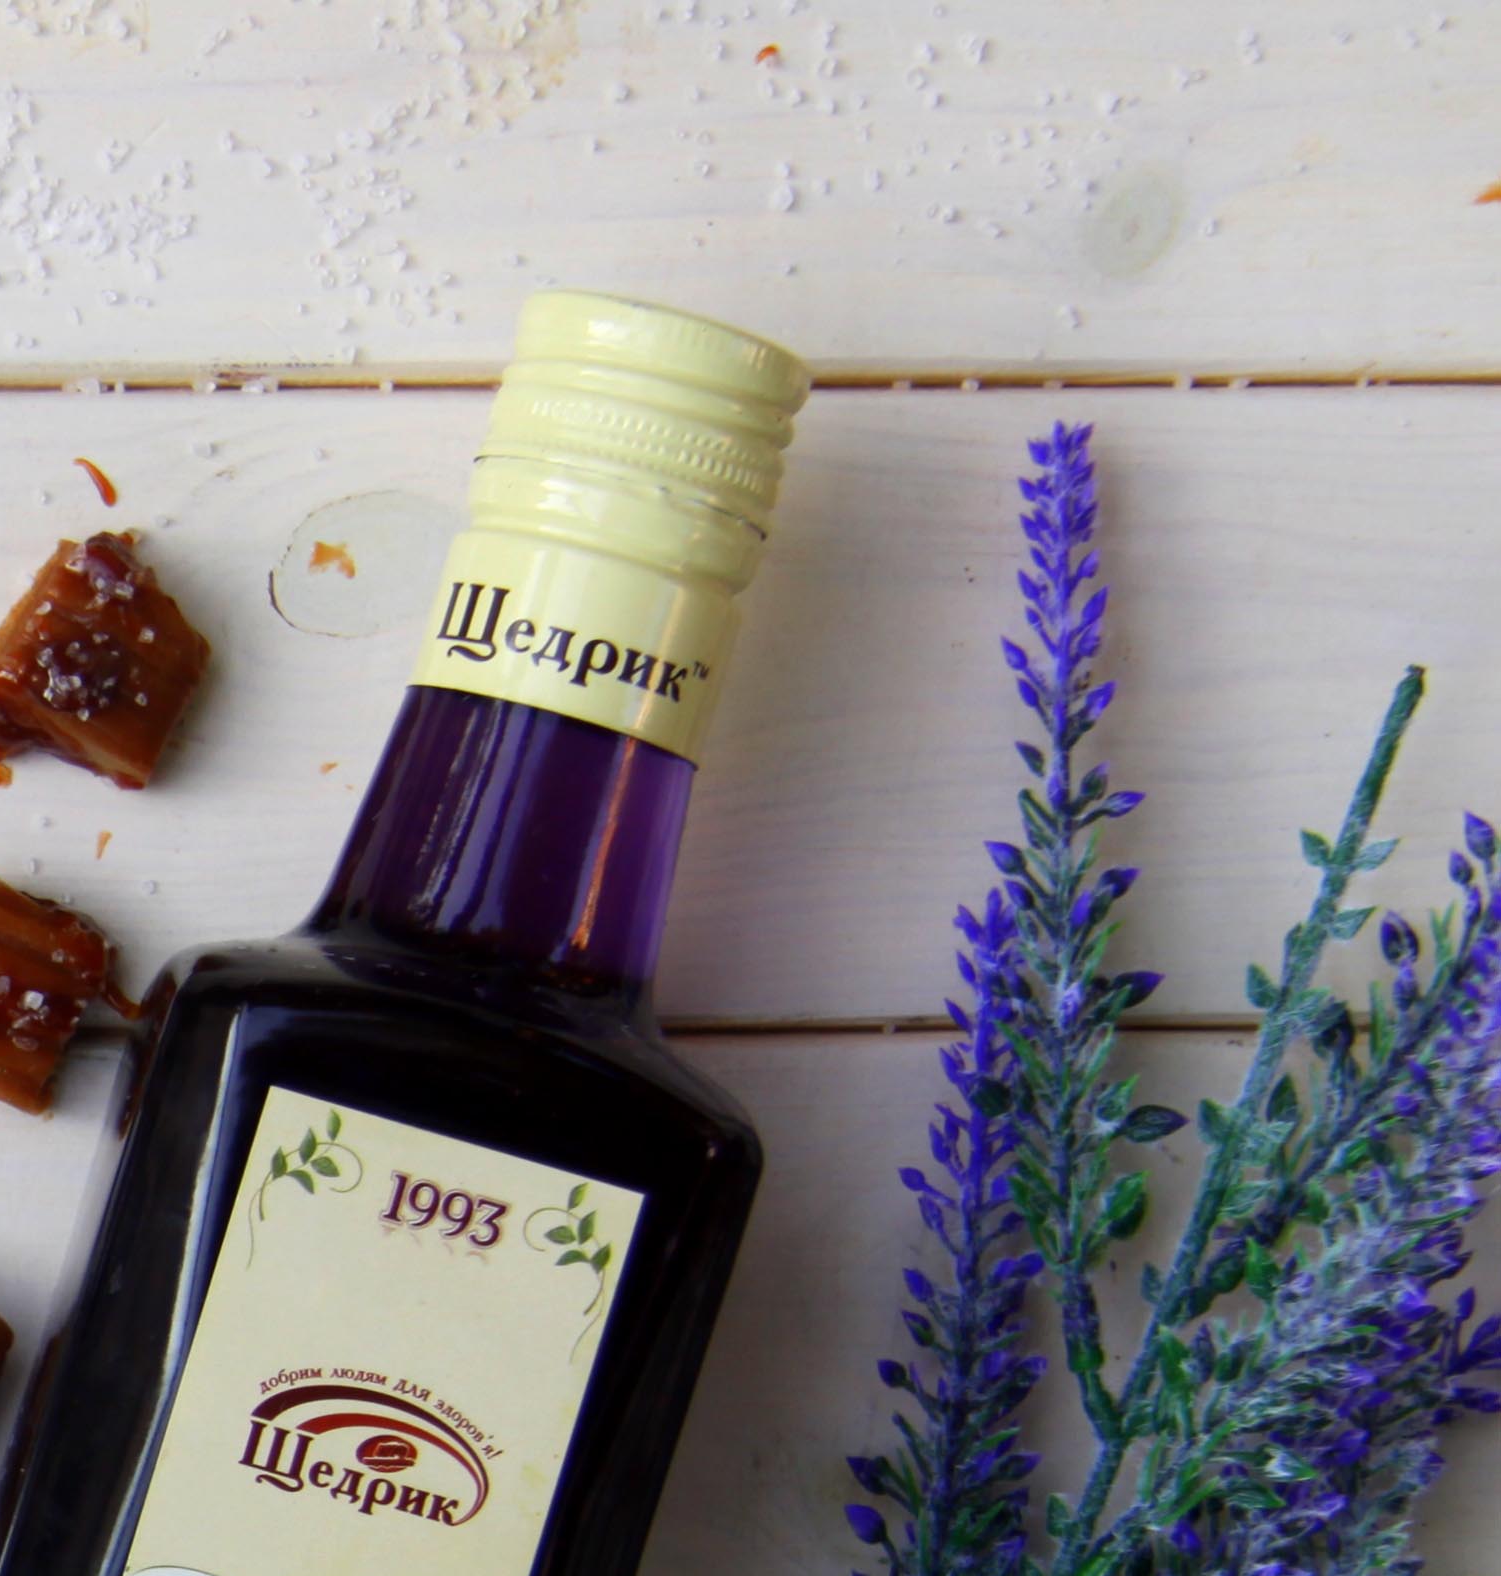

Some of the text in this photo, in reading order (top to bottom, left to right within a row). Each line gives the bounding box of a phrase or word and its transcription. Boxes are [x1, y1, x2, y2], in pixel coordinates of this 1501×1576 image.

[380, 1170, 509, 1249] 1993
[258, 1367, 322, 1395] добрим
[330, 1367, 387, 1386] людям
[238, 1419, 460, 1526] Щедрик
